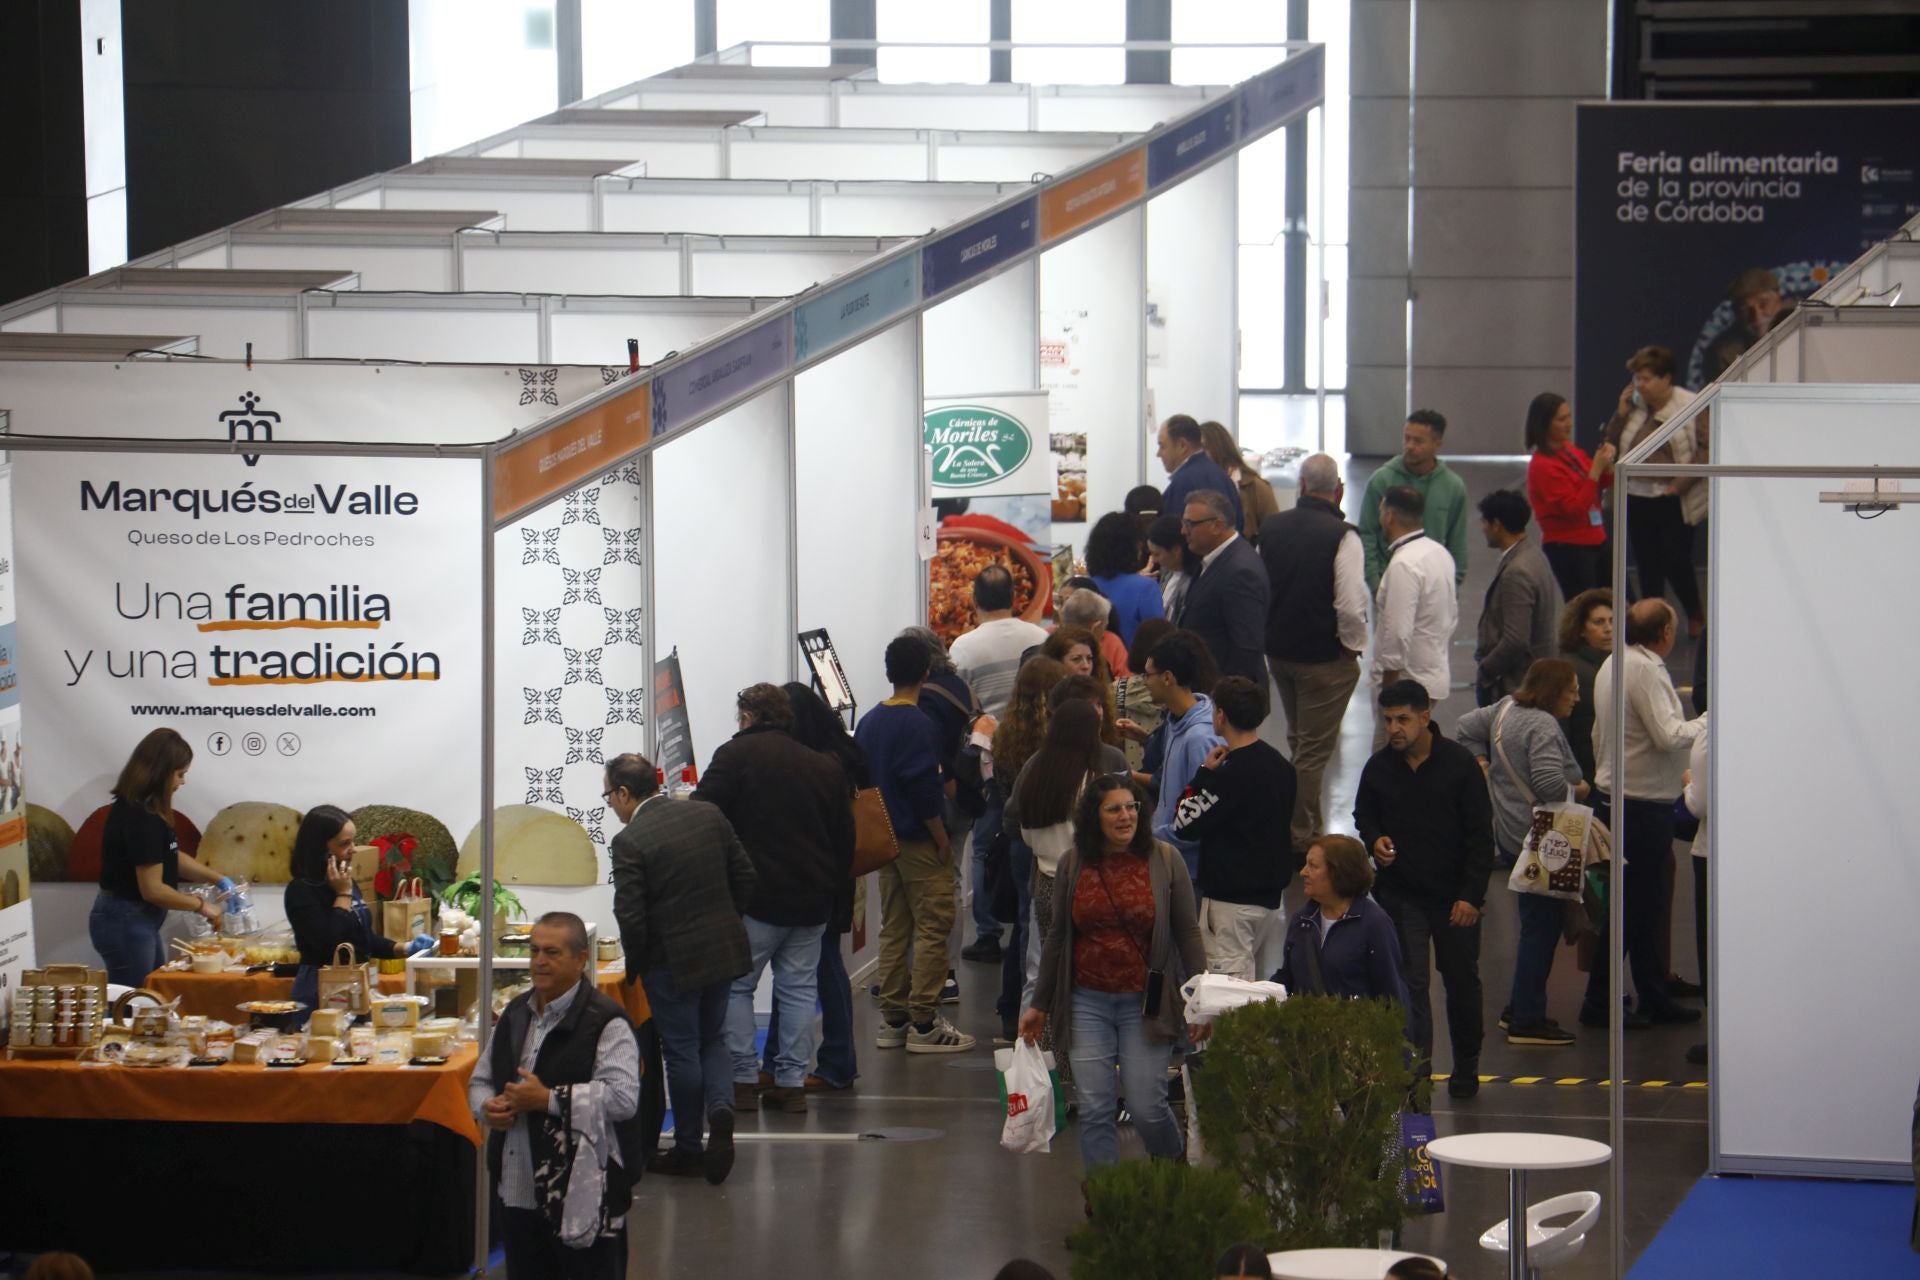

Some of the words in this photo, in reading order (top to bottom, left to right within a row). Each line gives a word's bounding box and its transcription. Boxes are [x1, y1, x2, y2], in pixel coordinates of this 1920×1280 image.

[1618, 151, 1682, 174] Feria
[1689, 151, 1839, 174] alimentaria
[1617, 177, 1649, 197] de
[1658, 177, 1680, 197] la
[1689, 177, 1801, 201] provincia
[1616, 202, 1649, 222] de
[1655, 199, 1764, 223] Córdoba
[949, 418, 986, 428] Cárnicas
[988, 416, 998, 426] de
[931, 427, 998, 445] Moriles
[81, 480, 282, 519] Marqués
[284, 493, 315, 509] del
[315, 484, 418, 515] Valle
[128, 529, 194, 547] Queso
[196, 530, 221, 545] de
[224, 531, 261, 545] Los
[264, 531, 375, 547] Pedroches
[116, 582, 213, 622] Una
[225, 583, 391, 623] familia
[64, 648, 93, 686] y
[107, 648, 197, 679] una
[210, 640, 440, 681] tradición
[131, 703, 376, 719] www.marquesdelvalle.com
